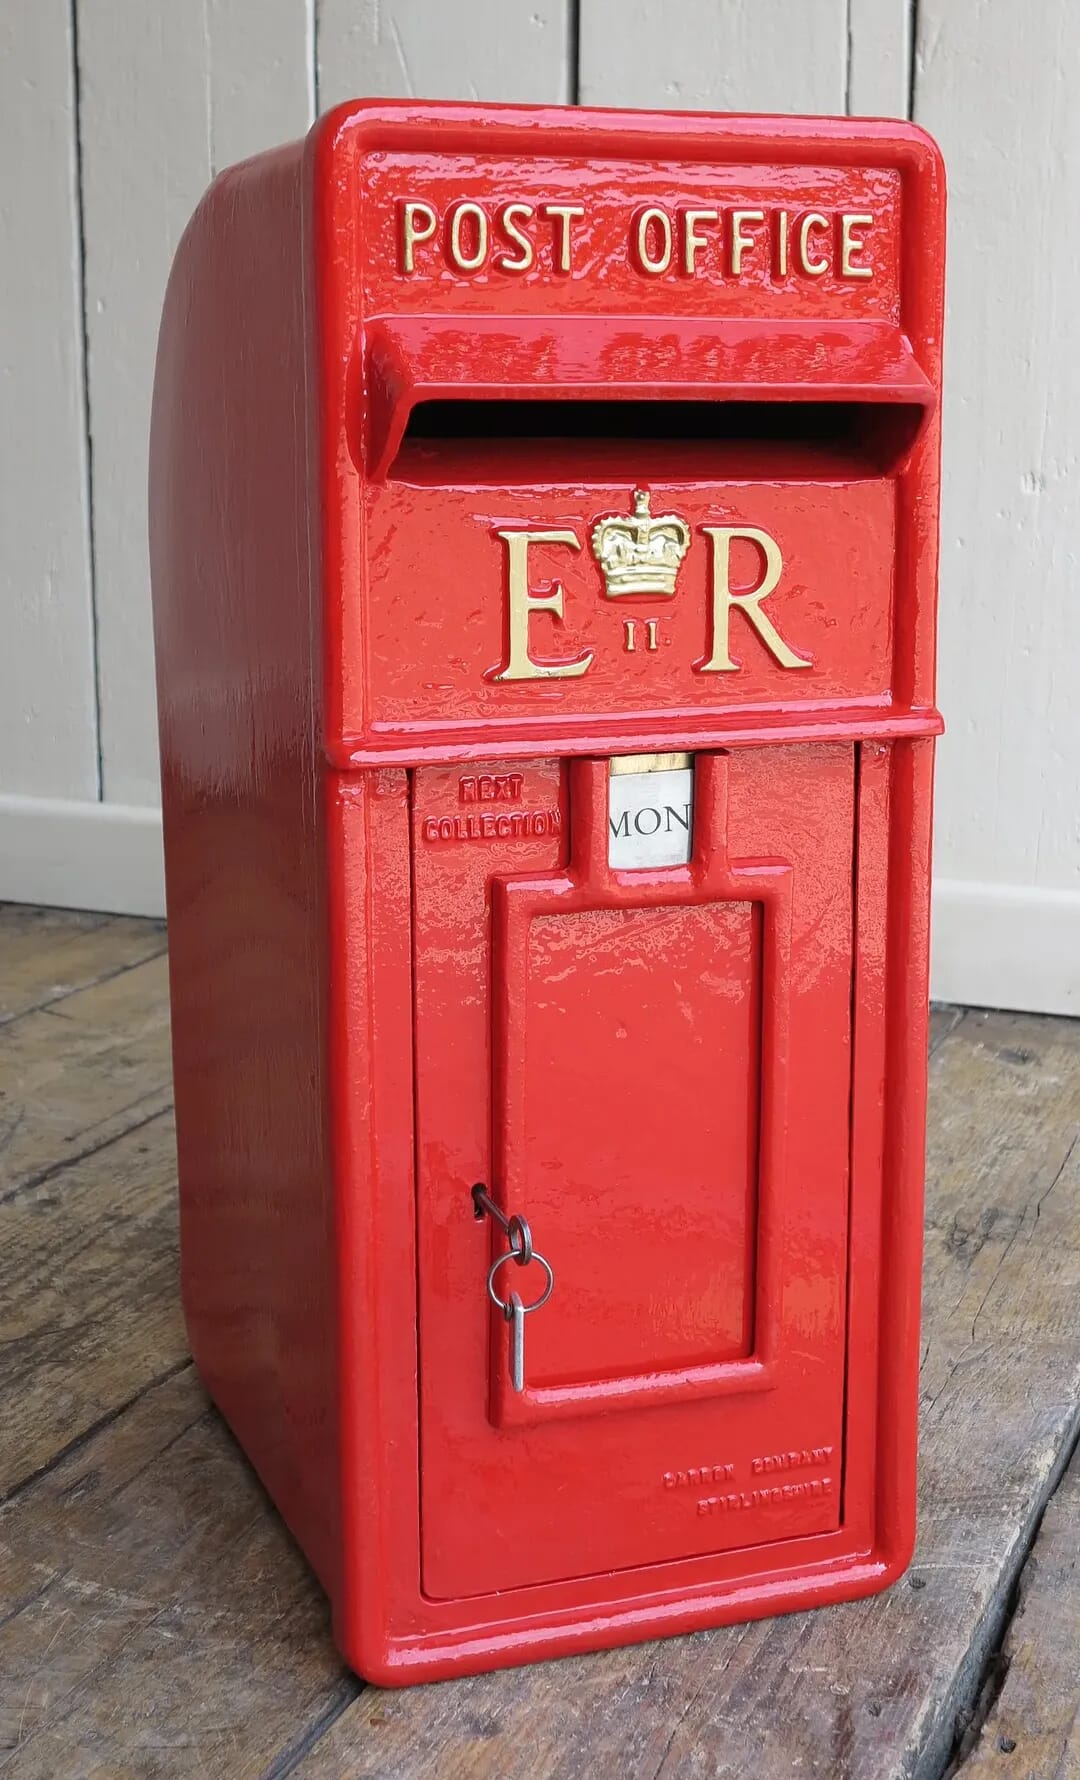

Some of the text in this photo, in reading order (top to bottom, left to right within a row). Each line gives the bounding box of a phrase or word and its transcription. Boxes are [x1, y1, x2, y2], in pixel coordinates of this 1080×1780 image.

[404, 203, 874, 278] POST OFFICE
[493, 527, 813, 681] E R
[461, 775, 523, 801] NEXT
[424, 810, 561, 841] COLLECTION
[609, 803, 692, 839] MON
